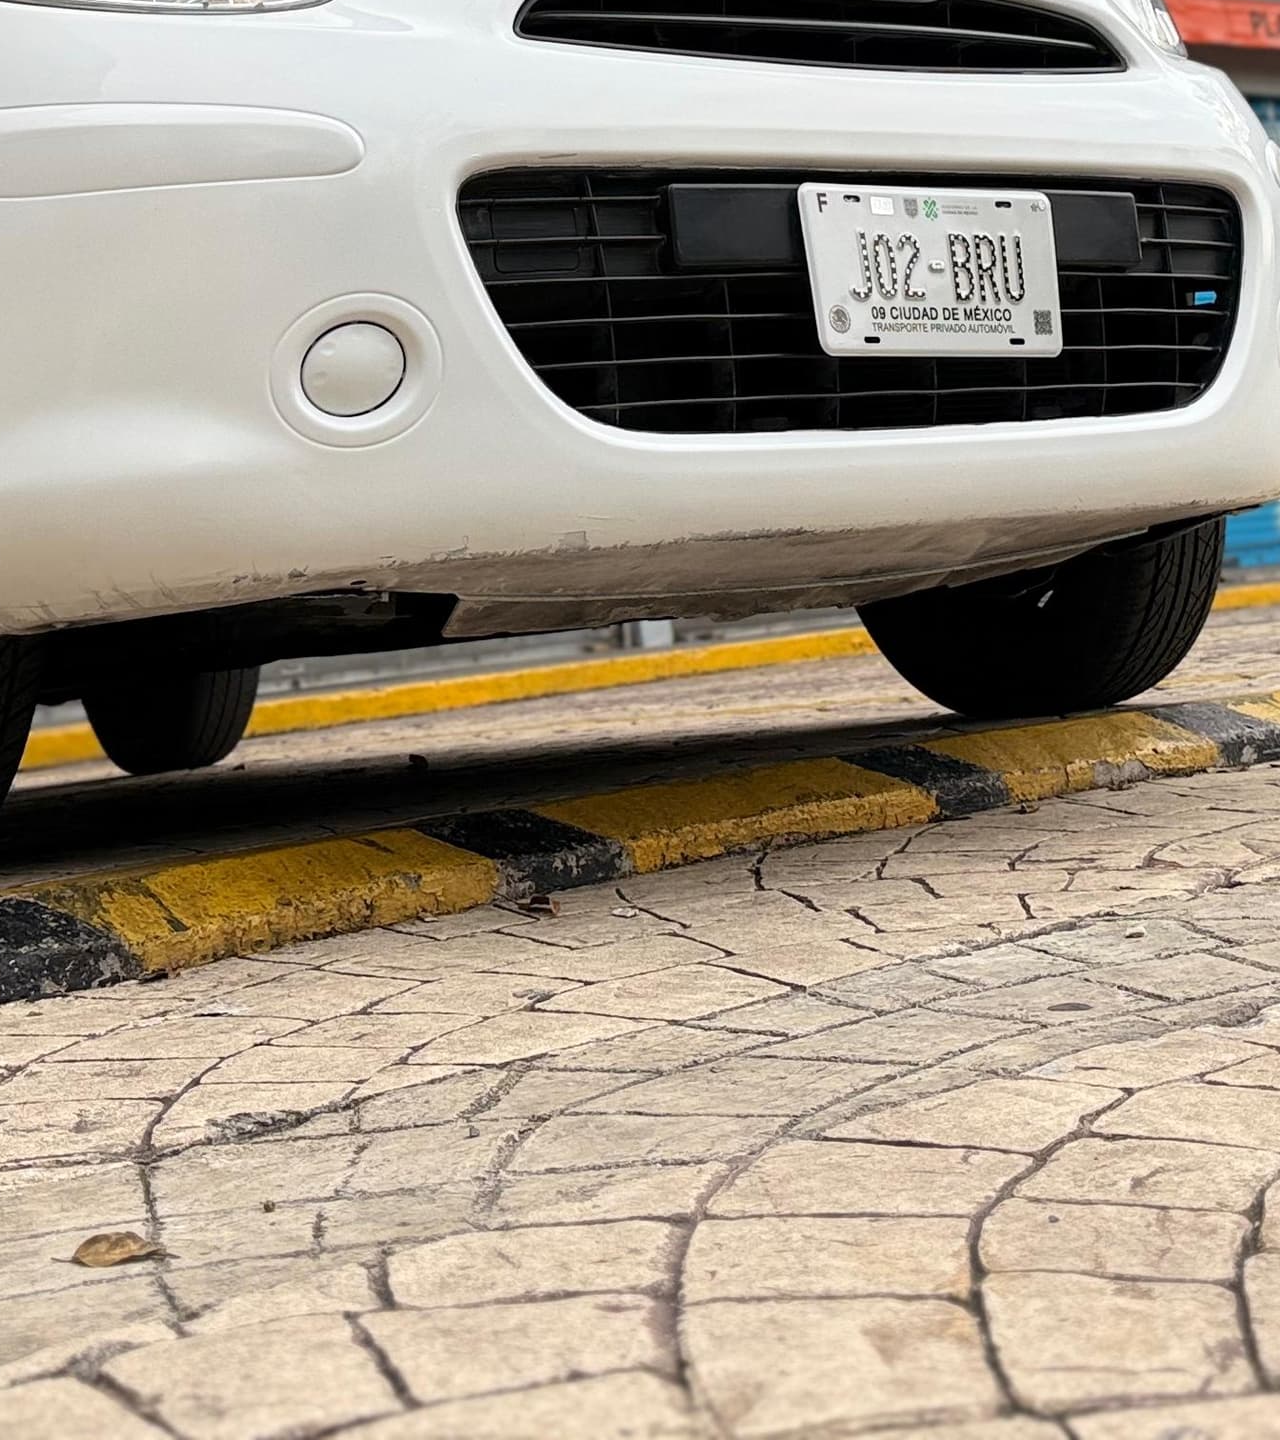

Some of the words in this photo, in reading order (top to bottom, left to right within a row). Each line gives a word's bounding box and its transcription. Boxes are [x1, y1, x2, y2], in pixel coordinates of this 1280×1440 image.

[816, 192, 828, 213] F
[871, 305, 886, 321] 09
[889, 306, 939, 321] CIUDAD
[942, 307, 960, 321] DE
[963, 305, 1012, 322] MÉXICO
[871, 322, 928, 334] TRANSPORTE
[930, 323, 967, 334] PRIVADO
[968, 323, 1016, 335] AUTOMÓVIL
